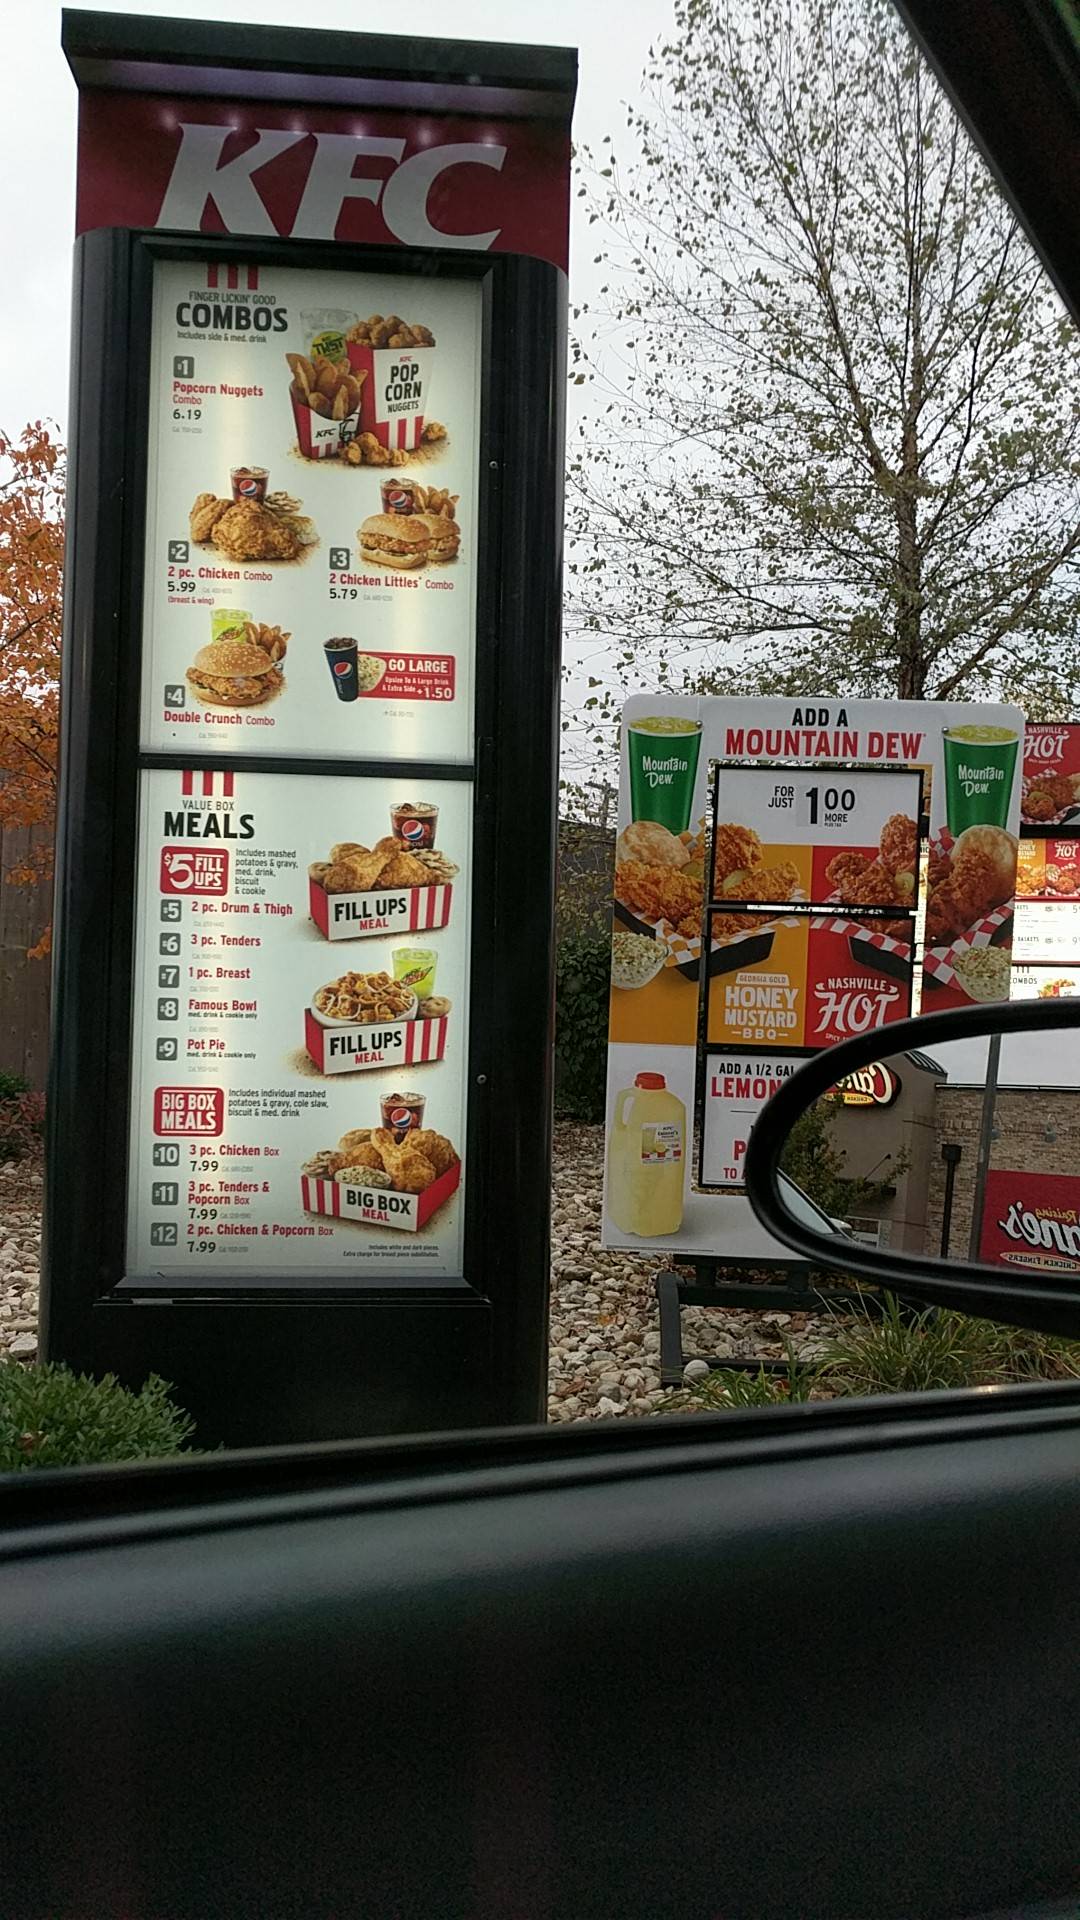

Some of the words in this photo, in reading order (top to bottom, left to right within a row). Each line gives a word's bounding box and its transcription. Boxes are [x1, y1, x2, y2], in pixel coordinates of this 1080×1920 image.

[154, 122, 507, 251] KFC
[189, 291, 219, 302] FINGER
[253, 295, 277, 305] GOOD
[176, 302, 288, 332] COMBOS
[177, 331, 206, 340] Includes
[208, 332, 222, 341] side
[224, 333, 228, 342] &
[249, 335, 267, 343] drink
[390, 364, 419, 383] POP
[173, 381, 216, 395] Popcorn
[220, 384, 264, 398] Nuggets
[385, 381, 422, 402] CORN
[173, 394, 202, 405] Combo
[387, 400, 419, 413] NUGGETS
[173, 408, 202, 420] 6.19
[315, 428, 337, 438] KFC
[168, 566, 175, 577] 2
[179, 568, 195, 579] pc.
[198, 567, 240, 580] Chicken
[243, 571, 273, 582] Combo
[168, 581, 196, 592] 5.99
[329, 573, 336, 584] 2
[340, 574, 381, 587] Chicken
[425, 579, 454, 590] Combo
[329, 588, 358, 600] 5.79
[388, 658, 406, 672] GO
[408, 659, 449, 673] LARGE
[164, 710, 201, 723] Double
[204, 712, 242, 725] Crunch
[246, 715, 275, 726] Combo
[792, 708, 829, 727] ADD
[836, 709, 848, 727] A
[1028, 726, 1062, 734] NASHVILLE
[726, 728, 858, 758] MOUNTAIN
[868, 732, 922, 759] DEW
[1023, 734, 1070, 759] HOT
[643, 756, 688, 771] Mountain
[958, 764, 1004, 780] Mountain
[774, 785, 794, 797] FOR
[182, 800, 212, 811] VALUE
[216, 801, 234, 811] BOX
[768, 797, 794, 808] JUST
[824, 813, 848, 823] MORE
[164, 811, 255, 839] MEALS
[236, 848, 266, 858] Includes
[268, 850, 296, 858] mashed
[1055, 844, 1079, 858] HOT
[195, 857, 224, 872] FILL
[235, 859, 268, 869] potatoes
[270, 859, 275, 867] &
[277, 860, 299, 869] gravy,
[235, 868, 251, 876] med.
[255, 868, 276, 877] drink,
[195, 872, 223, 887] UPS
[235, 877, 259, 885] biscuit
[235, 887, 240, 895] &
[242, 887, 266, 895] cookie
[192, 901, 199, 912] 2
[202, 903, 218, 914] pc.
[222, 902, 249, 914] Drum
[253, 903, 260, 914] &
[264, 903, 293, 917] Thigh
[334, 900, 372, 922] FILL
[376, 897, 407, 917] UPS
[359, 918, 389, 931] MEAL
[191, 934, 198, 945] 3
[201, 935, 217, 947] pc.
[221, 935, 261, 947] Tenders
[188, 967, 193, 977] 1
[197, 968, 212, 980] pc.
[216, 967, 251, 979] Breast
[739, 975, 767, 983] GEORGIA
[828, 977, 887, 992] NASHVILLE
[1010, 977, 1038, 985] OMBOS
[725, 985, 799, 1009] HONEY
[188, 999, 228, 1011] Famous
[232, 1000, 257, 1011] Bowl
[245, 1012, 257, 1020] only
[724, 1008, 798, 1028] MUSTARD
[813, 991, 900, 1033] HOT
[187, 1039, 206, 1050] Pot
[209, 1039, 226, 1050] Pie
[330, 1034, 367, 1056] FILL
[371, 1031, 402, 1049] UPS
[243, 1052, 256, 1060] only
[355, 1052, 384, 1064] MEAL
[719, 1063, 740, 1075] ADD
[745, 1064, 752, 1075] A
[756, 1063, 771, 1076] 1/2
[228, 1088, 259, 1098] Includes
[261, 1089, 296, 1098] individual
[298, 1090, 326, 1098] mashed
[711, 1076, 782, 1099] LEMON
[161, 1093, 185, 1110] BIG
[188, 1094, 216, 1111] BOX
[228, 1099, 261, 1108] potatoes
[263, 1099, 268, 1107] &
[294, 1100, 309, 1108] cole
[311, 1100, 329, 1109] slaw,
[228, 1108, 252, 1117] biscuit
[254, 1109, 259, 1117] &
[261, 1109, 279, 1117] med.
[161, 1111, 217, 1130] MEALS
[189, 1144, 197, 1156] 3
[200, 1147, 215, 1158] pc.
[219, 1145, 260, 1156] Chicken
[263, 1146, 280, 1157] Box
[189, 1160, 219, 1172] 7.99
[723, 1167, 737, 1179] TO
[188, 1181, 196, 1192] 3
[199, 1183, 214, 1194] pc.
[218, 1181, 259, 1193] Tenders
[262, 1182, 270, 1193] &
[188, 1194, 231, 1206] Popcorn
[234, 1195, 250, 1205] Box
[346, 1189, 374, 1208] BIG
[378, 1195, 411, 1215] BOX
[188, 1208, 218, 1220] 7.99
[362, 1208, 390, 1221] MEAL
[187, 1224, 194, 1235] 2
[197, 1226, 213, 1237] pc.
[217, 1225, 258, 1236] Chicken
[261, 1225, 269, 1236] &
[272, 1225, 315, 1238] Popcorn
[318, 1226, 334, 1236] Box
[187, 1241, 216, 1253] 7.99
